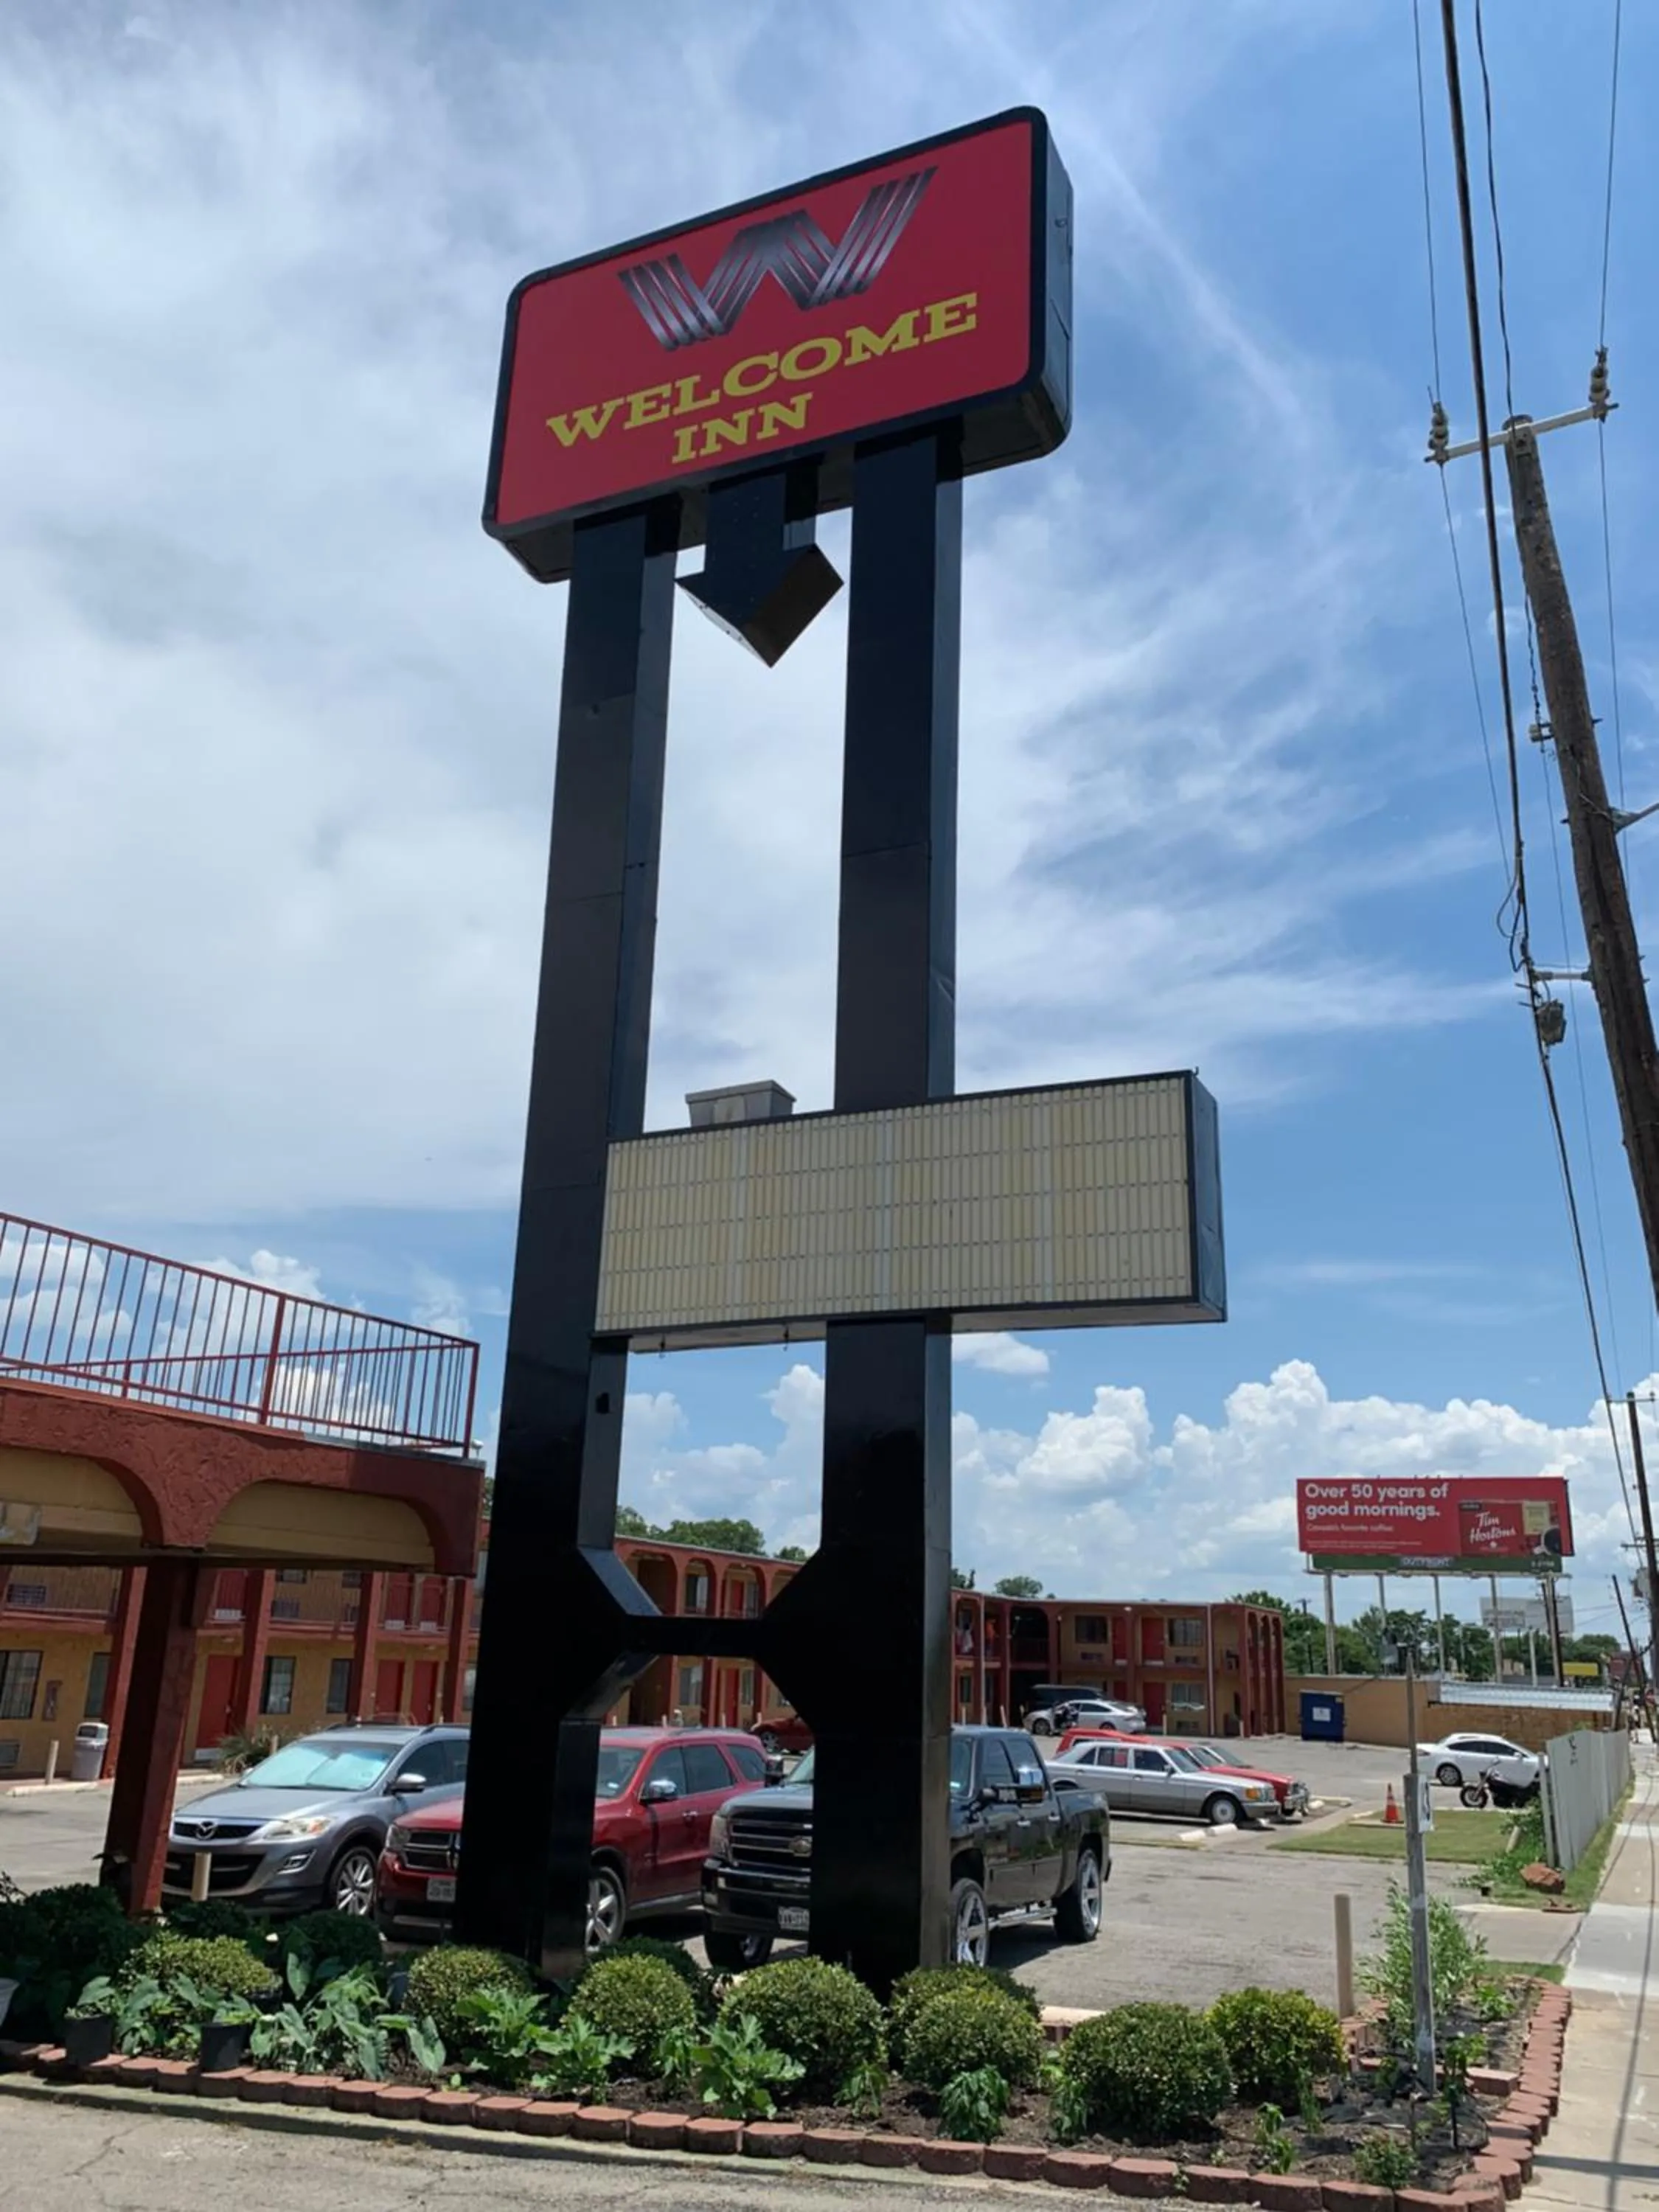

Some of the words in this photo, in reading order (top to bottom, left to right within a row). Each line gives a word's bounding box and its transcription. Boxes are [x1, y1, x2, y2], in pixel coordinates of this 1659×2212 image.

[546, 293, 978, 447] WELCOME
[672, 392, 813, 465] INN
[1305, 1483, 1347, 1498] Over
[1351, 1484, 1373, 1498] 50
[1377, 1486, 1426, 1503] years
[1430, 1483, 1449, 1498] of
[1306, 1500, 1349, 1520] good
[1354, 1500, 1440, 1521] mornings.
[1476, 1512, 1500, 1527] Tim
